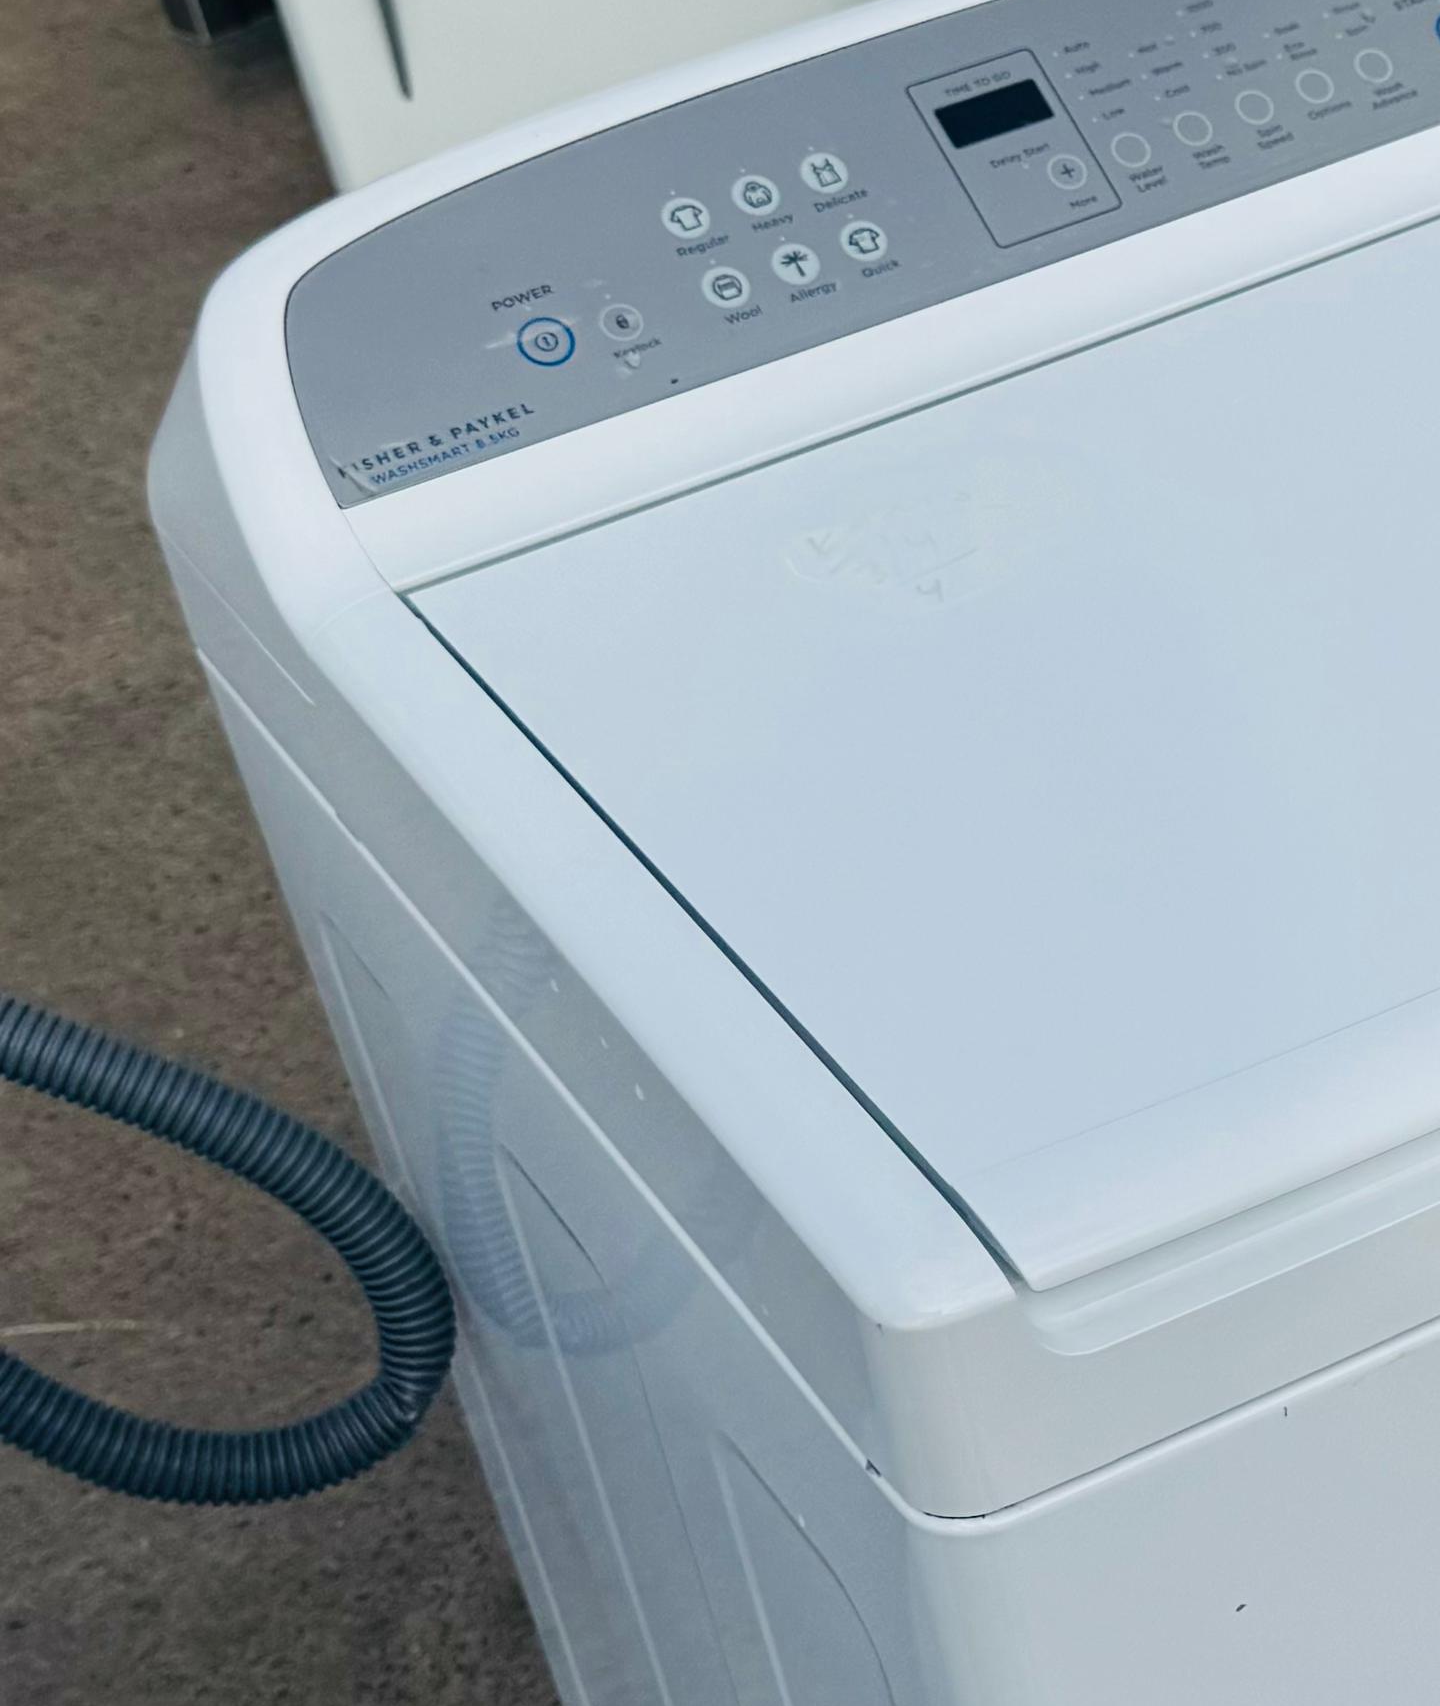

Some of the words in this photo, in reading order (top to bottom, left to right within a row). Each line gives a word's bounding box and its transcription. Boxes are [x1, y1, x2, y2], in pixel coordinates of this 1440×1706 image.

[813, 187, 868, 213] Delicate
[751, 213, 794, 232] Heavy
[676, 234, 729, 258] Regular
[861, 259, 901, 278] Quick
[491, 284, 554, 312] POWER
[790, 281, 837, 304] Allergy
[724, 305, 763, 325] Wool
[429, 433, 443, 447] &
[450, 403, 535, 440] PAYKEL
[369, 443, 470, 485] WASHSMART
